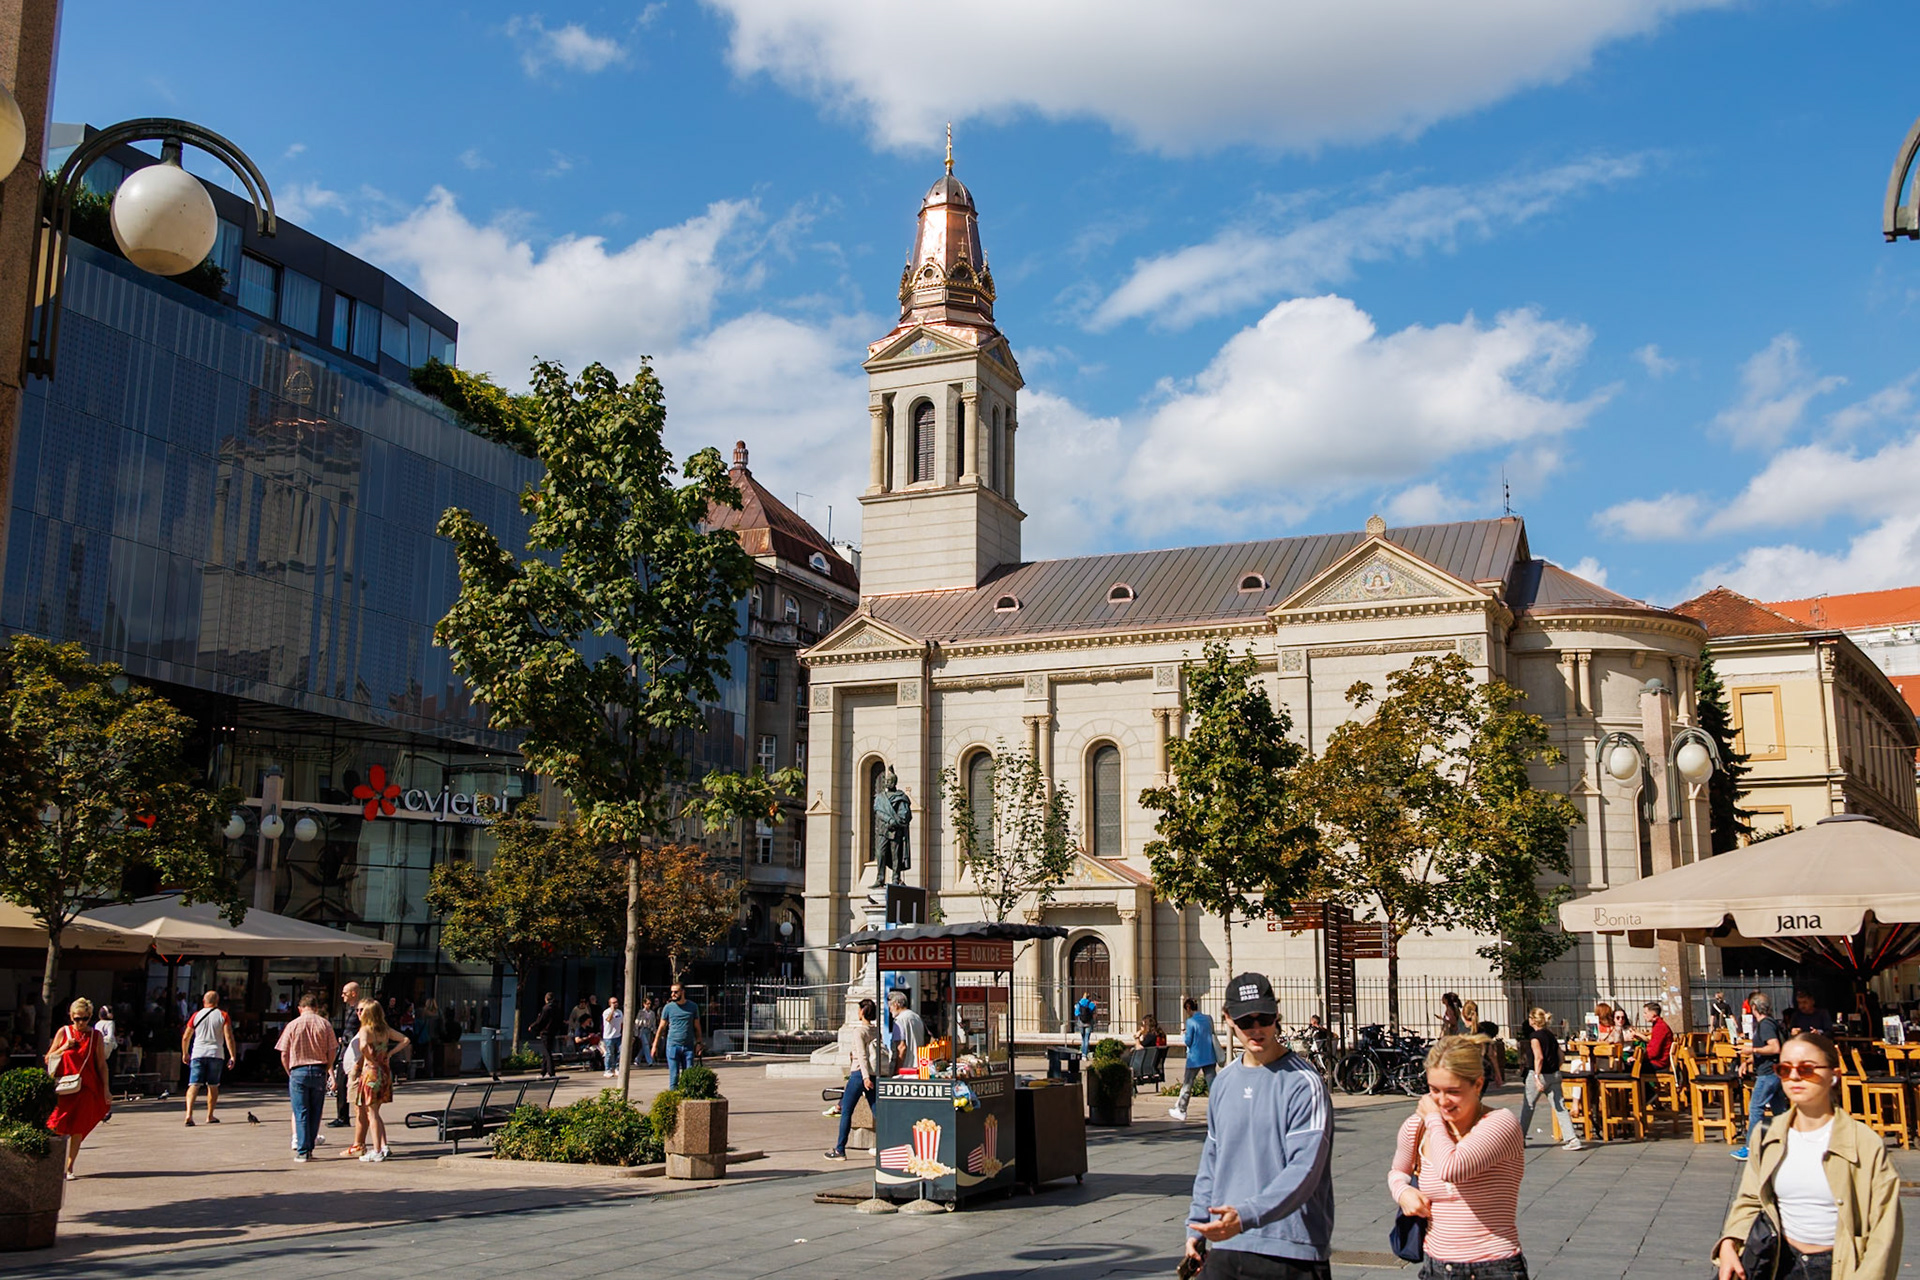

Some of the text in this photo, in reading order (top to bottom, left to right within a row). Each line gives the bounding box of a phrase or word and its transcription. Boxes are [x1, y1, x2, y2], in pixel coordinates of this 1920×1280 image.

[1593, 907, 1642, 926] Bonita
[1775, 914, 1822, 933] jana
[886, 946, 945, 960] KOKICE
[971, 946, 1000, 962] KOKICE
[887, 1084, 942, 1097] POPCORN
